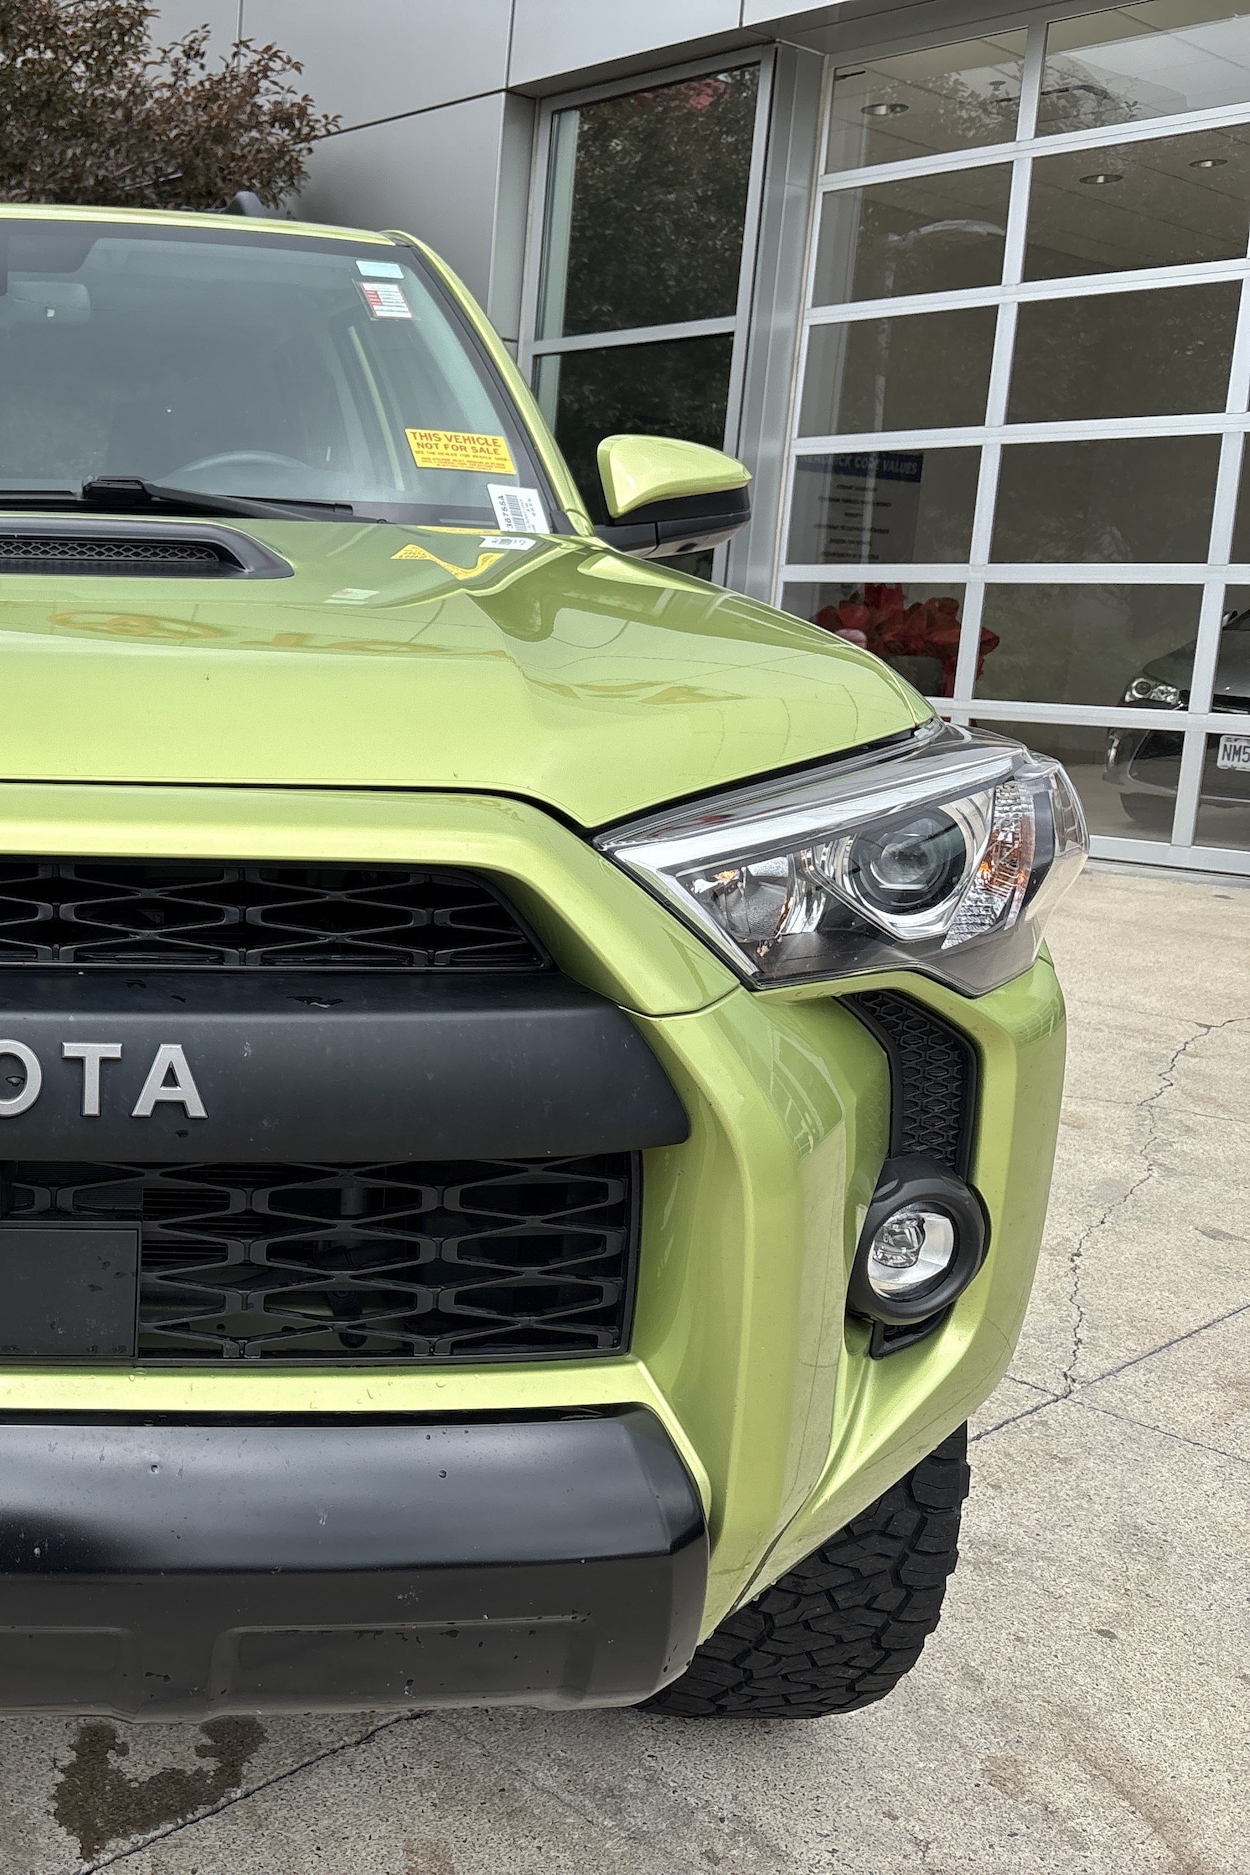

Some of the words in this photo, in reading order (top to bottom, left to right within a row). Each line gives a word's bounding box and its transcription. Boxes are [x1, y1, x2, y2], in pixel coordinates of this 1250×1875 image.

[410, 431, 442, 442] THIS
[444, 433, 501, 448] VEHICLE
[416, 442, 440, 450] NOT
[443, 443, 468, 452] FOR
[471, 446, 501, 456] SALE
[882, 459, 918, 475] VALUES
[1222, 744, 1250, 763] NM5
